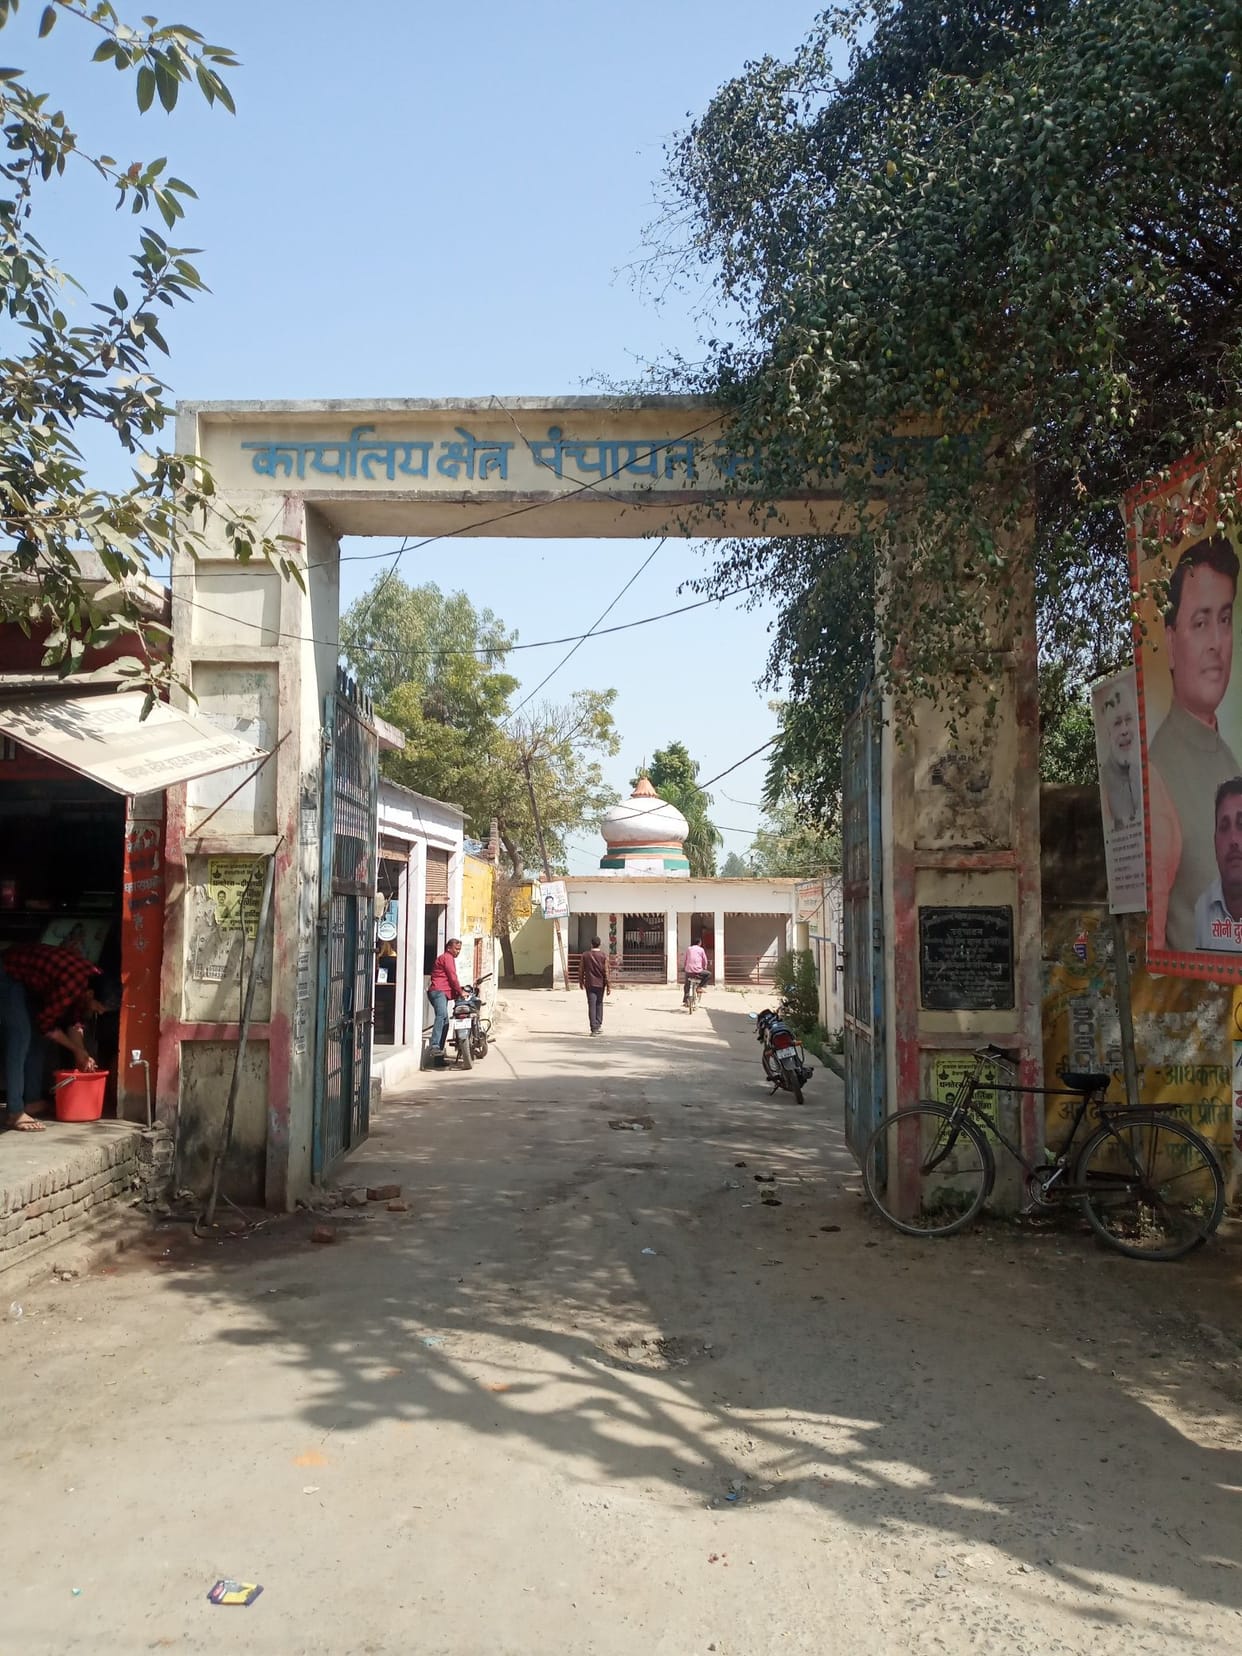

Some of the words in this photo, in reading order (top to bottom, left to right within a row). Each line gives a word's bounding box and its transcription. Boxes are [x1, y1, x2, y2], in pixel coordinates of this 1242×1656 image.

[241, 425, 433, 481] कार्यालय
[436, 426, 515, 481] क्षेत्र
[528, 426, 698, 481] पंचायत
[1211, 918, 1231, 938] सोनी
[1233, 923, 1242, 944] दु
